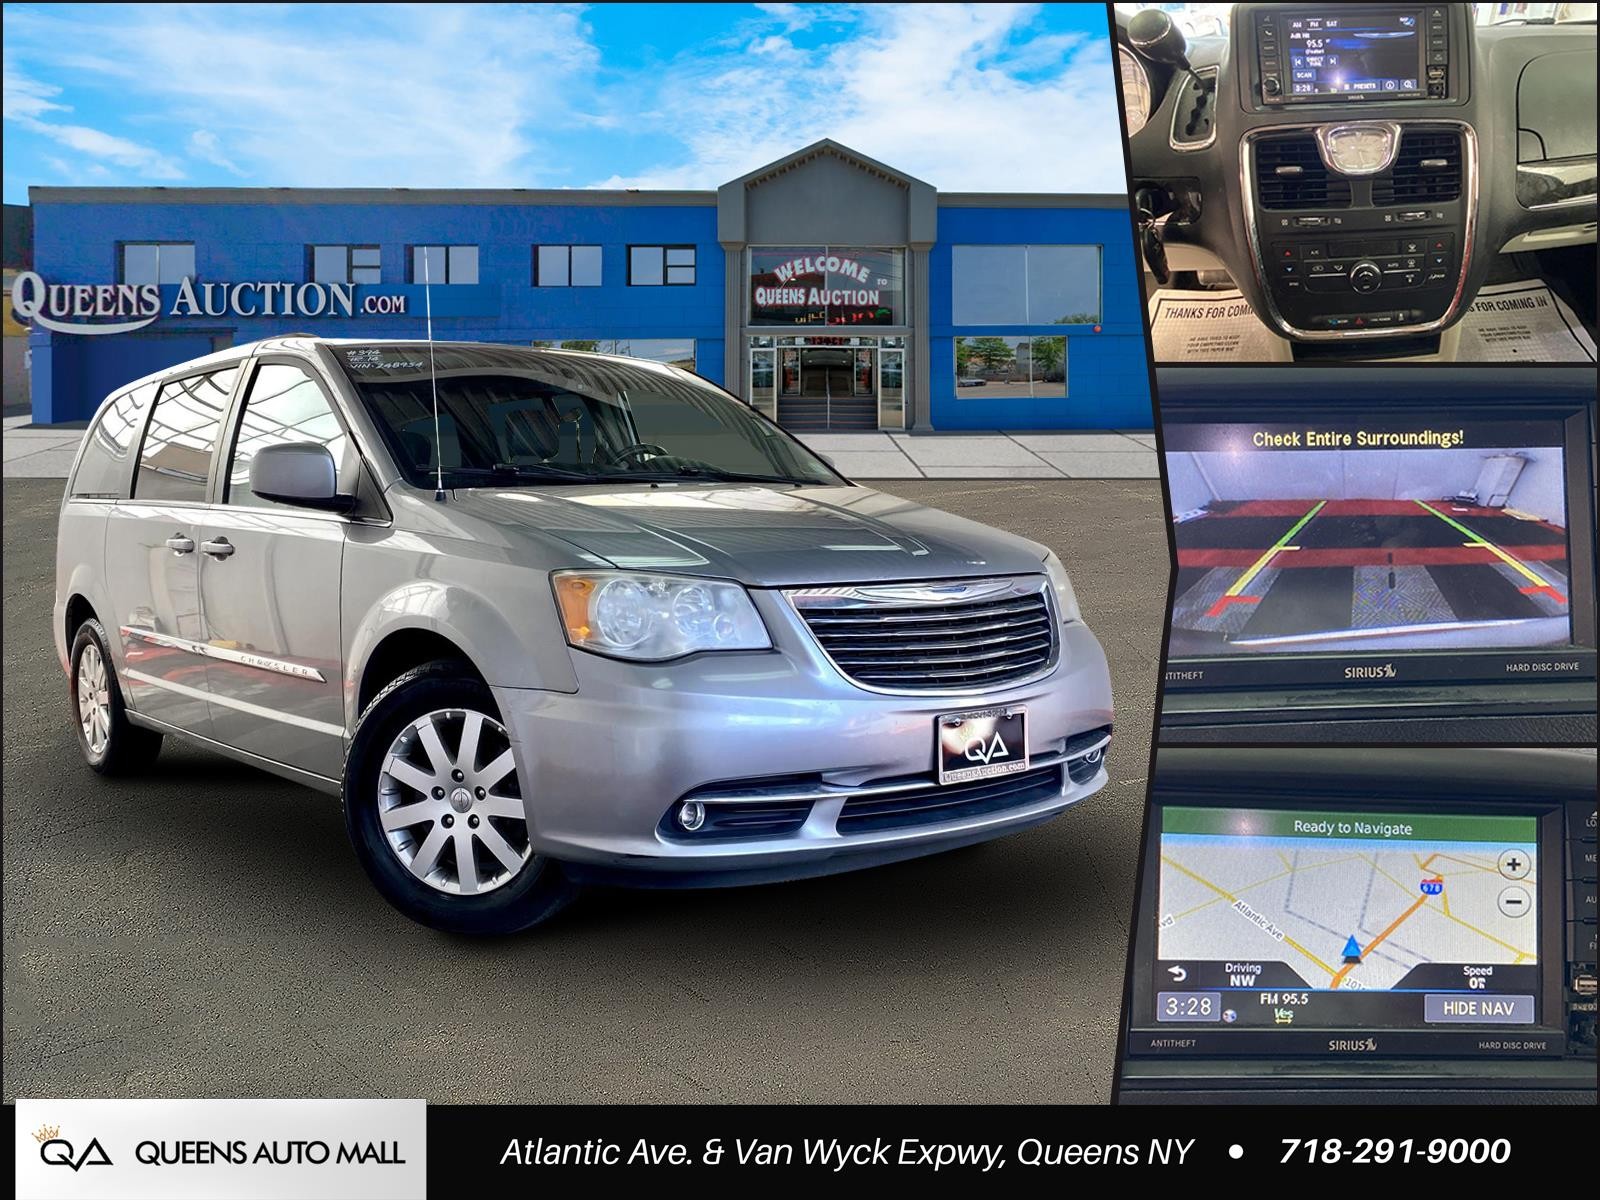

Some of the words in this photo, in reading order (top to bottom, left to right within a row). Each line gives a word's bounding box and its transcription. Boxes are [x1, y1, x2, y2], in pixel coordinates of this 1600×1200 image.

[1305, 39, 1324, 48] 95.5
[1353, 82, 1376, 90] PRESETS
[774, 256, 872, 284] WELCOME
[877, 278, 888, 286] TO
[755, 286, 806, 306] QUEENS
[808, 287, 880, 306] AUCTION
[12, 271, 161, 335] QUEENS
[1475, 301, 1497, 312] FOR
[1496, 297, 1536, 312] COMING
[1536, 295, 1549, 308] IN
[1165, 306, 1205, 319] THANKS
[1206, 306, 1225, 319] FOR
[1253, 432, 1301, 447] Check
[1306, 431, 1352, 447] Entire
[1356, 430, 1465, 449] Surroundings!
[241, 656, 308, 675] CHRYSLER
[1506, 664, 1530, 673] HARD
[1531, 663, 1553, 672] DISC
[1554, 662, 1580, 672] DRIVE
[1344, 666, 1384, 679] SIRIUS
[1293, 820, 1335, 836] Ready
[1337, 822, 1351, 833] to
[1354, 822, 1413, 837] Navigate
[1422, 884, 1441, 893] 678
[1233, 900, 1267, 929] Atlantic
[1265, 923, 1284, 940] Ave
[1225, 963, 1262, 975] Driving
[1463, 966, 1493, 976] Speed
[1230, 976, 1256, 986] NW
[1260, 993, 1279, 1004] FM
[1282, 993, 1308, 1004] 95.5
[1165, 997, 1212, 1015] 3:28
[1444, 1001, 1477, 1015] HIDE
[1482, 1001, 1515, 1016] NAV
[1151, 1039, 1196, 1048] ANTITHEFT
[1329, 1040, 1364, 1051] SIRIUS
[1479, 1041, 1502, 1050] HARD
[1503, 1041, 1522, 1050] DISC
[1524, 1041, 1547, 1050] DRIVE
